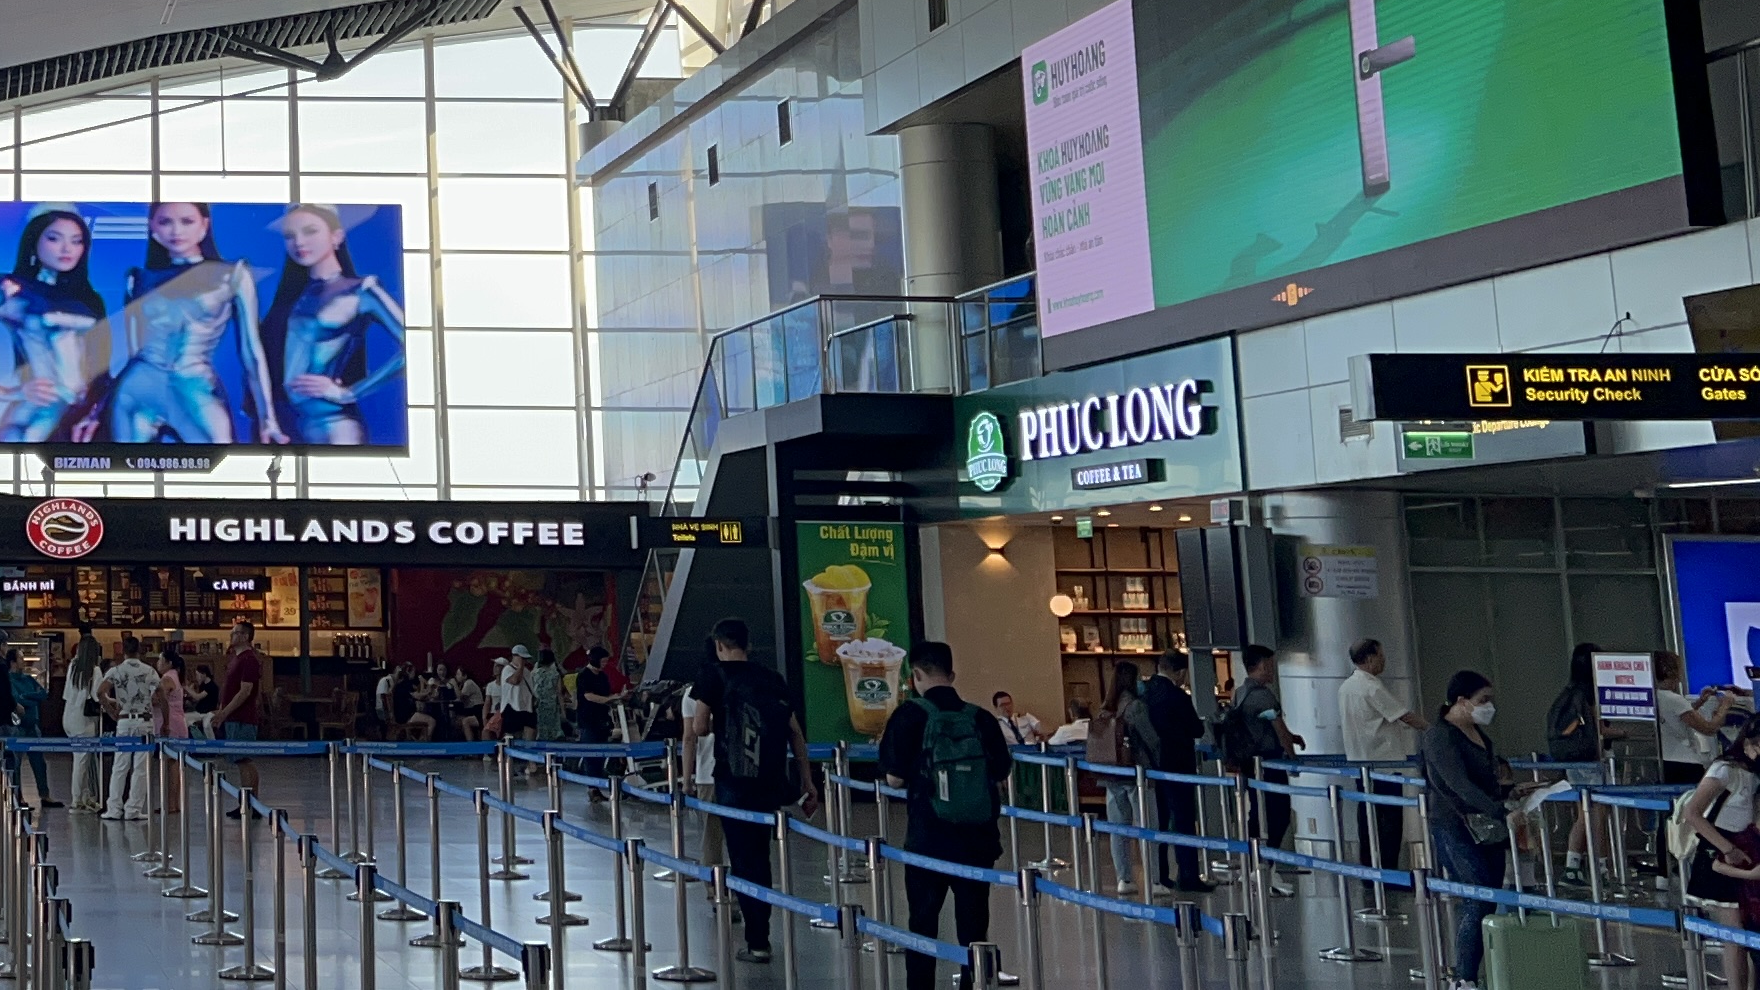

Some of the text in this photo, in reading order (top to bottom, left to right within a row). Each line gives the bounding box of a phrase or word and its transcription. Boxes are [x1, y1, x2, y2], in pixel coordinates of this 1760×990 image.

[1051, 40, 1105, 90] HUYHOANG
[1061, 124, 1109, 165] HUYHOANG
[1567, 369, 1601, 382] TRA
[1603, 369, 1628, 382] AN
[1631, 368, 1671, 382] NINH
[1699, 366, 1736, 382] CỬA
[1526, 387, 1642, 404] Security Check
[1701, 387, 1747, 401] Gates
[1106, 379, 1202, 448] LONG
[54, 457, 111, 469] BIZMAN
[1077, 463, 1142, 486] COFFEE & TEA
[31, 501, 99, 528] HIGHLANDS
[170, 517, 585, 546] HIGHLANDS COFFEE
[820, 525, 893, 542] Chất Lượng
[39, 540, 90, 555] COFFEE
[850, 543, 895, 560] Đậm vị
[3, 579, 55, 592] BÁNH MÌ
[213, 579, 255, 591] CÀ PHÊ
